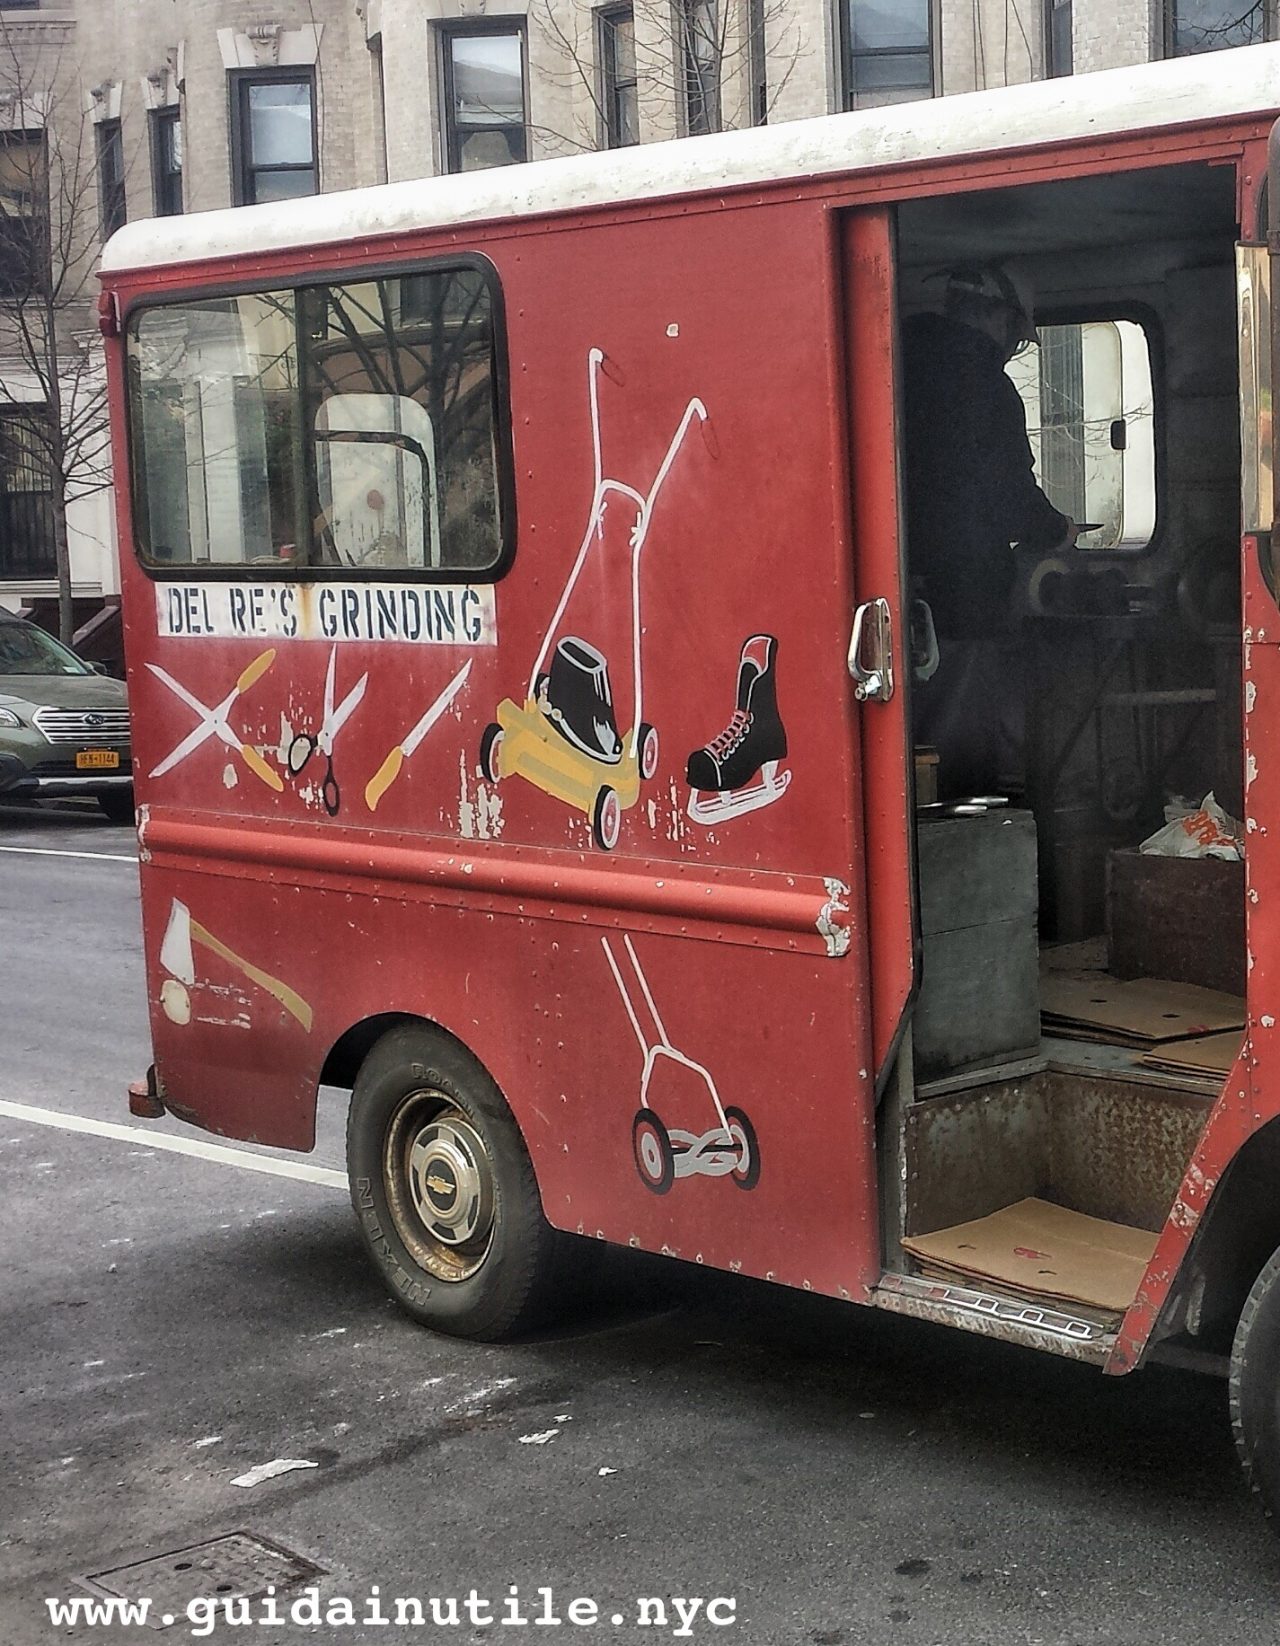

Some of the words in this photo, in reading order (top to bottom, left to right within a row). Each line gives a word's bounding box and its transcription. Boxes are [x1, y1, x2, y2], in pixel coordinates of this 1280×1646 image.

[168, 588, 214, 633] DEL
[229, 588, 297, 637] RE'S
[319, 589, 482, 641] GRINDING
